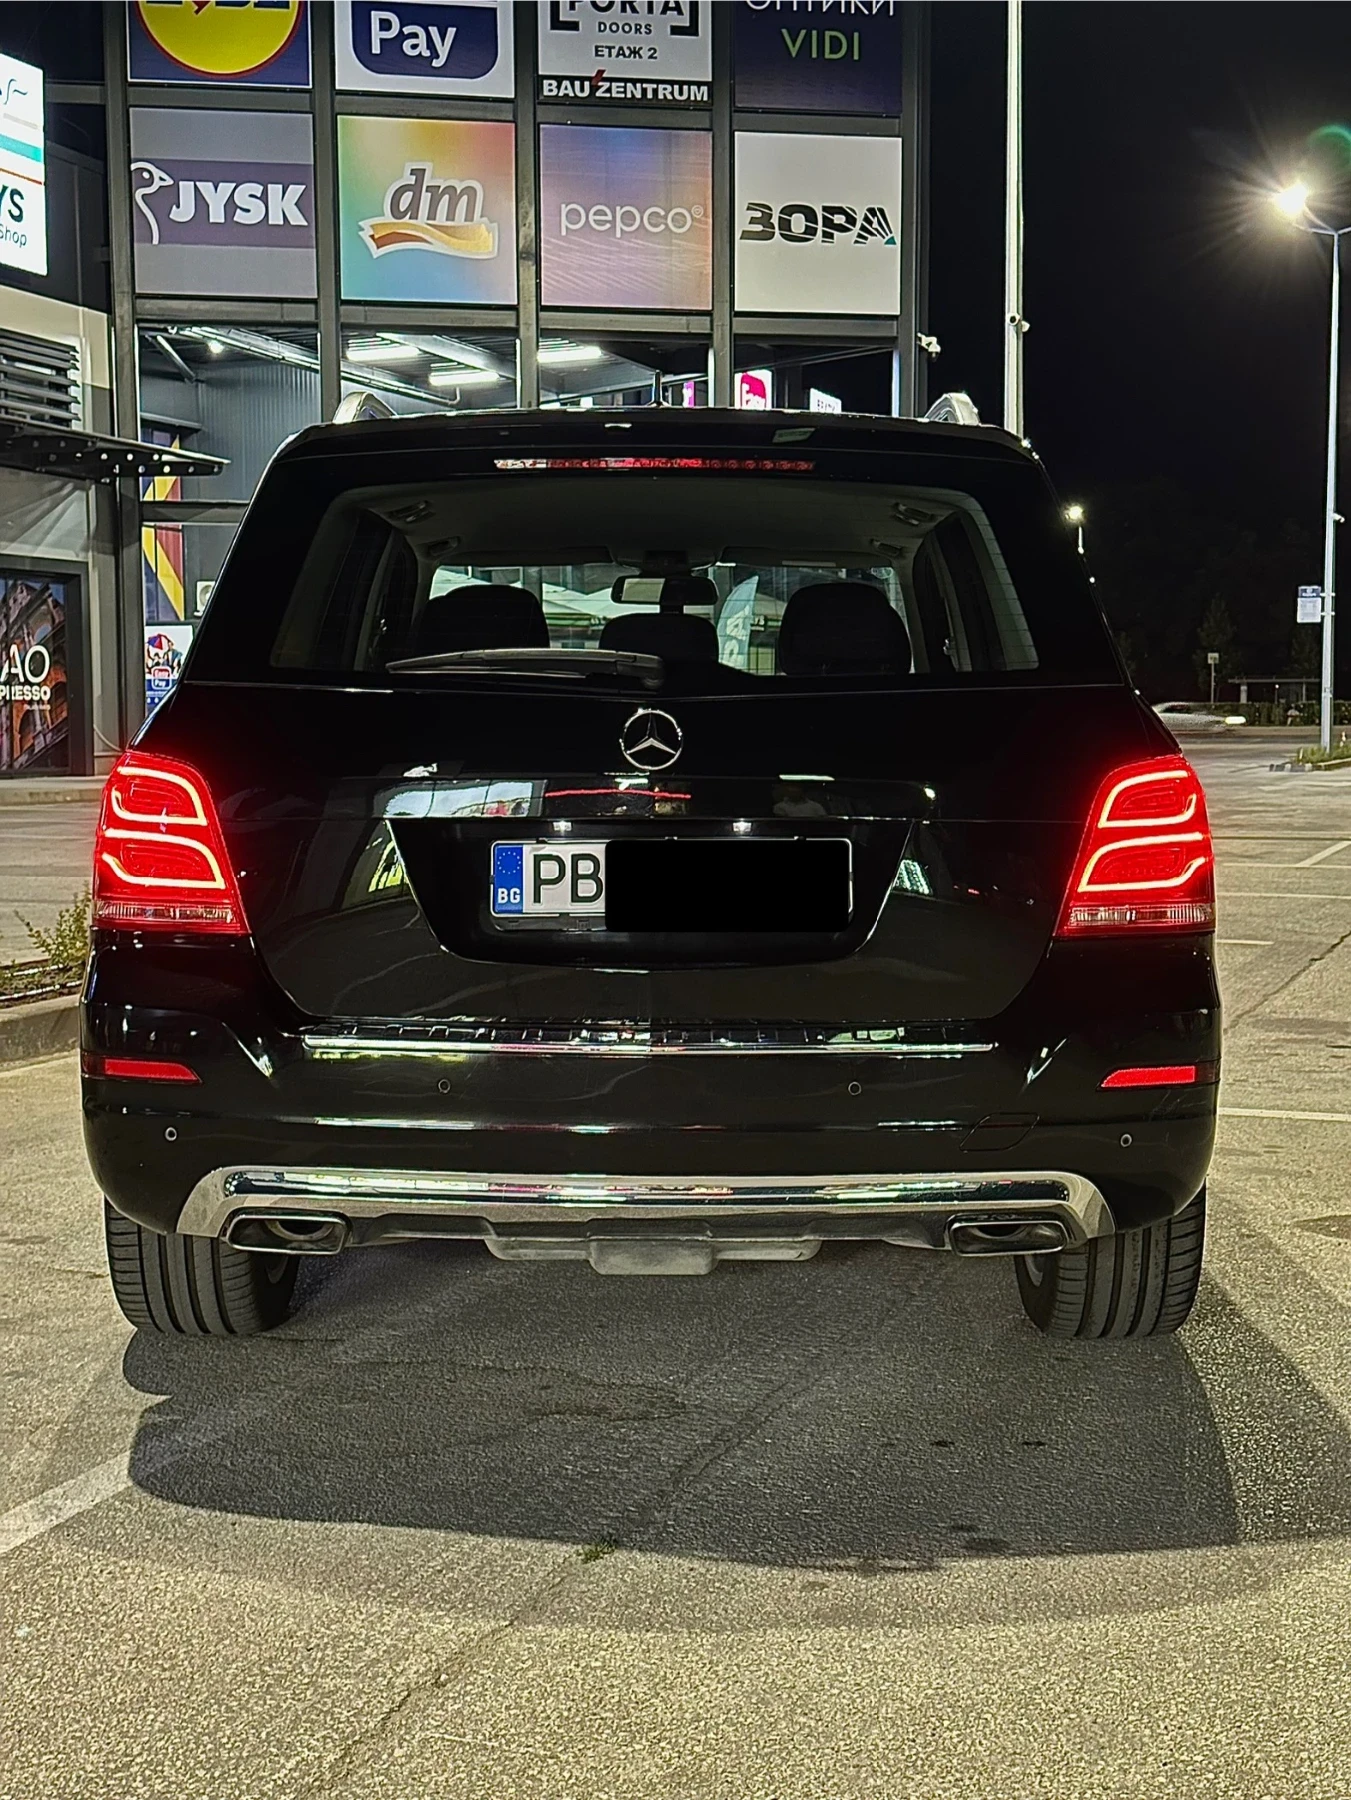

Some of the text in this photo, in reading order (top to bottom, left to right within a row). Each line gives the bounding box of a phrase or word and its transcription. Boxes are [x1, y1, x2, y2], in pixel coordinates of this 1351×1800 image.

[370, 10, 457, 68] Pay
[597, 21, 653, 36] DOORS
[781, 28, 859, 60] VIDI
[594, 44, 658, 60] ЕТАЖ 2
[169, 180, 309, 227] JYSK
[390, 168, 478, 223] dm
[560, 203, 692, 238] pepco
[740, 202, 897, 245] ЗОРА
[498, 853, 604, 904] BG PB
